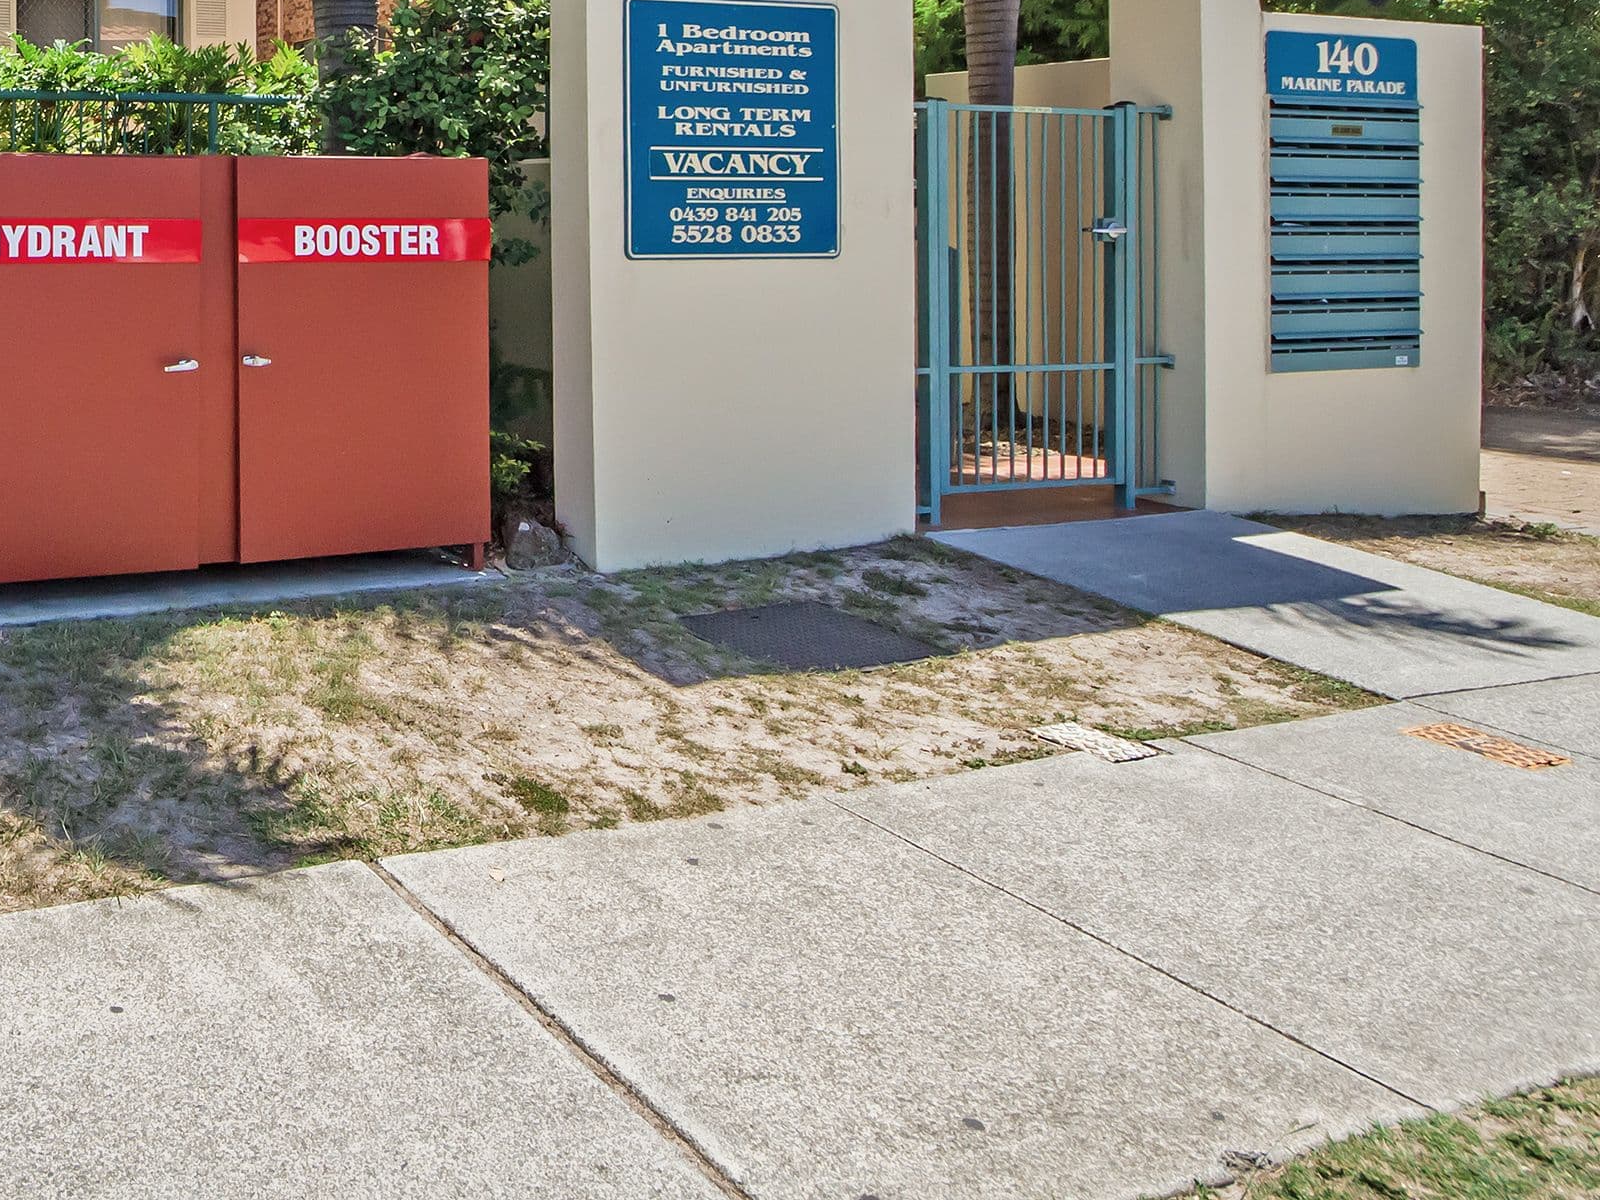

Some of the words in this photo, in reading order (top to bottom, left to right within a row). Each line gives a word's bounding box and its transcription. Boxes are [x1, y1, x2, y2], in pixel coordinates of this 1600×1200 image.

[657, 23, 668, 37] 1
[682, 24, 810, 43] Bedroom
[656, 39, 813, 57] Apartments
[1316, 39, 1378, 76] 140
[662, 65, 783, 79] FURNISHED
[788, 69, 807, 80] &
[660, 80, 809, 95] UNFURNISHED
[1281, 76, 1342, 92] MARINE
[1346, 79, 1406, 95] PARADE
[657, 106, 730, 121] LONG
[739, 108, 811, 122] TERM
[675, 122, 796, 137] RENTALS
[663, 153, 811, 174] VACANCY
[686, 187, 786, 200] ENQUIRIES
[670, 207, 718, 221] 0439
[725, 207, 757, 221] 841
[766, 208, 802, 221] 205
[294, 224, 440, 256] BOOSTER
[671, 225, 732, 243] 5528
[740, 225, 801, 243] 0833
